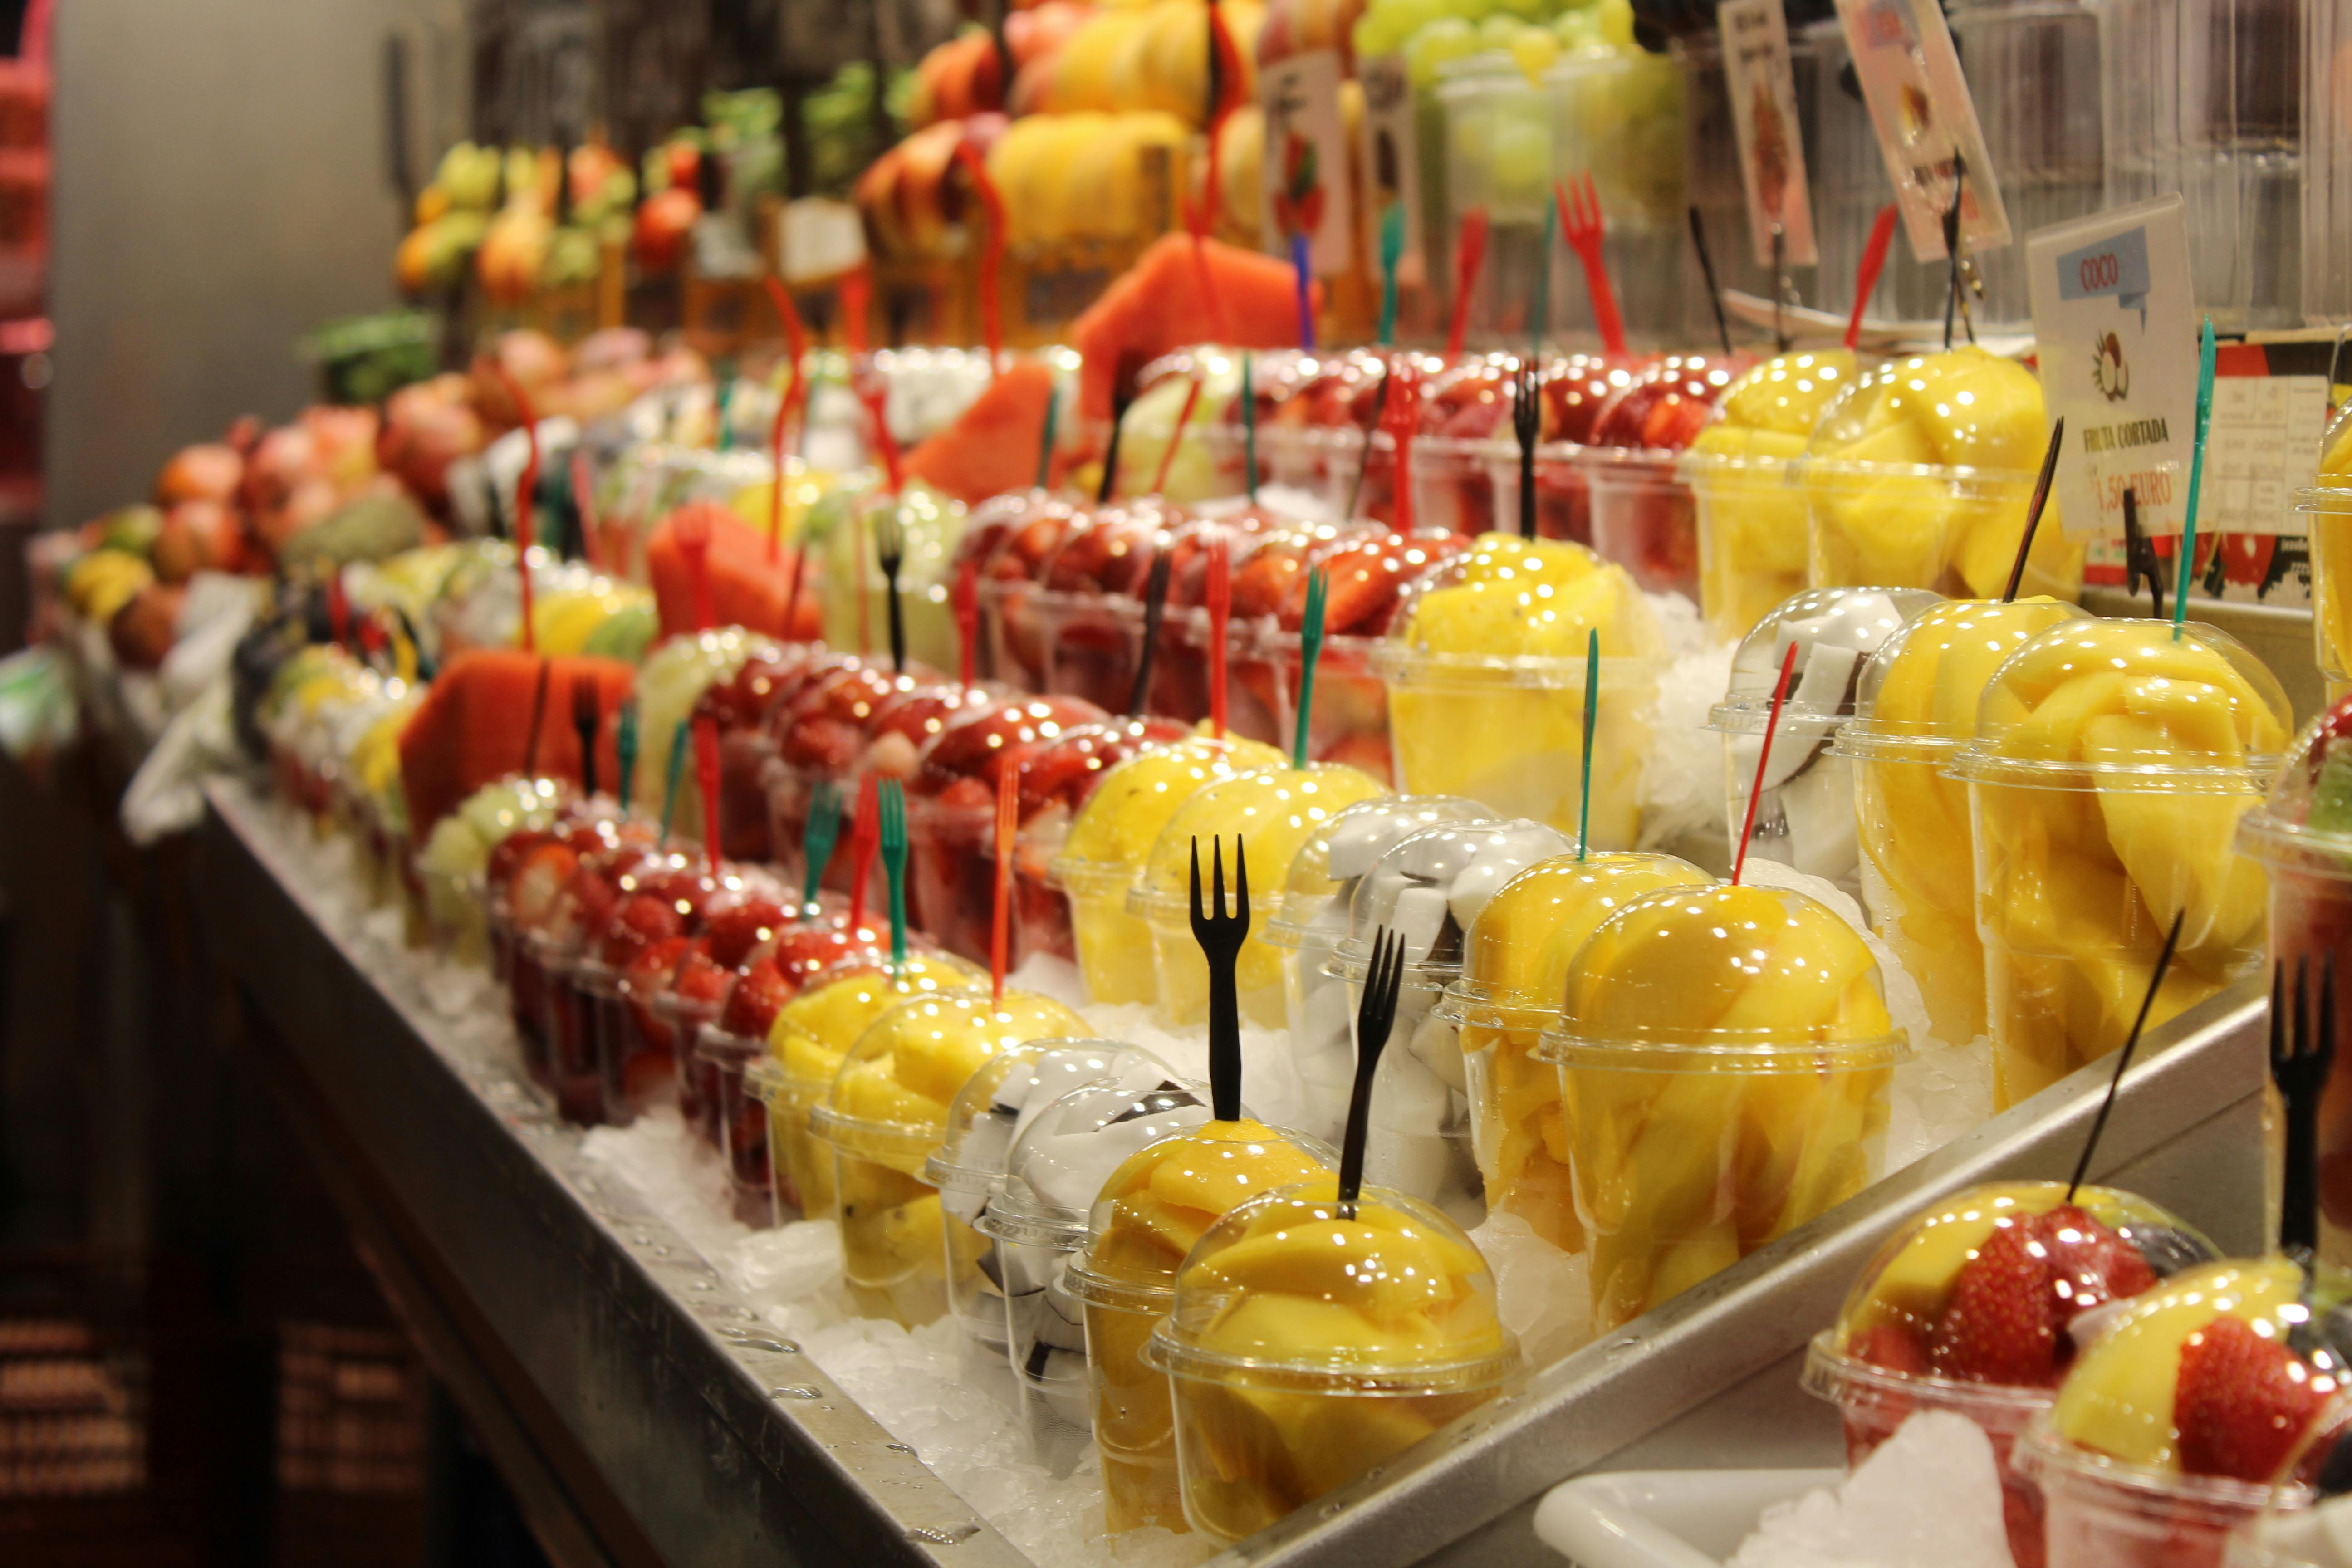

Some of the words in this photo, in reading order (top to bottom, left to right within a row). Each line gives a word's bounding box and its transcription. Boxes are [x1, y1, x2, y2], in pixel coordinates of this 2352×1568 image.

[2081, 253, 2118, 293] COCO
[2083, 425, 2115, 453] FRUTA
[2117, 416, 2169, 448] CORTADA
[2130, 470, 2171, 506] EURO
